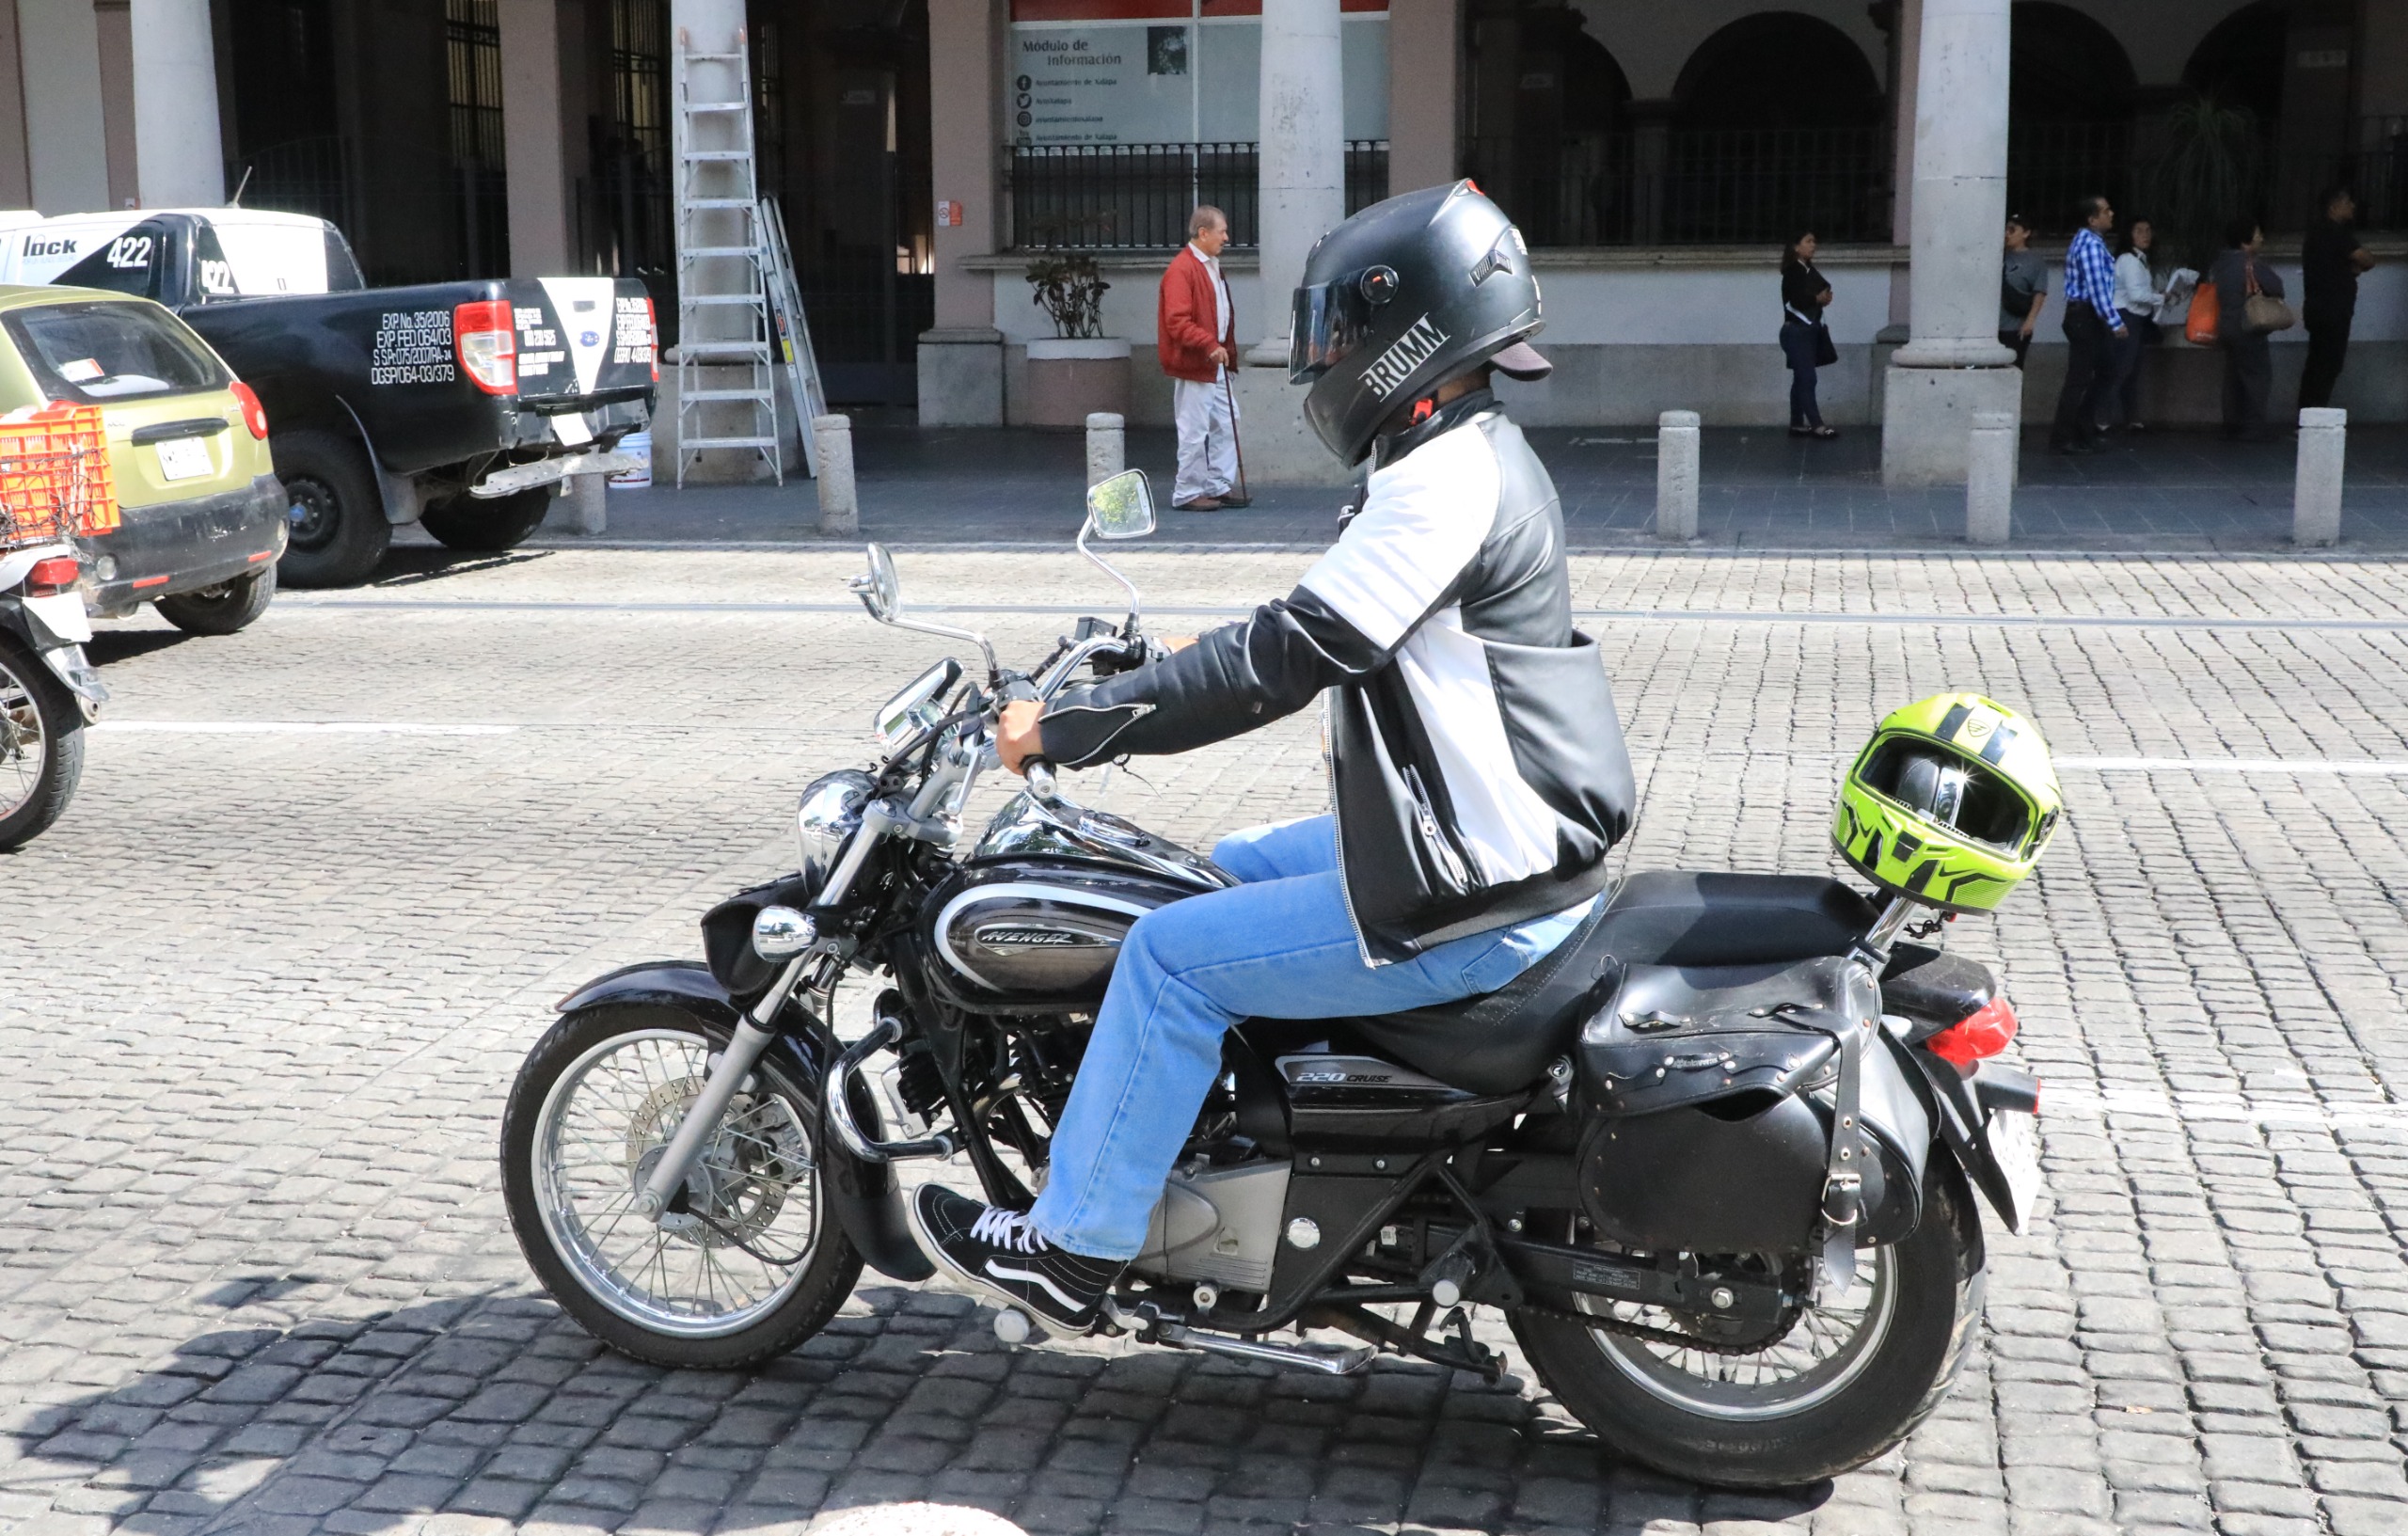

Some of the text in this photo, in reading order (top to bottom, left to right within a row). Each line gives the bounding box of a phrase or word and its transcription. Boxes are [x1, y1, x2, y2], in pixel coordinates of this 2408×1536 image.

[1022, 39, 1088, 52] Módulo de
[1047, 52, 1121, 66] Información
[106, 237, 152, 268] 422
[414, 310, 450, 328] 35/2006
[418, 328, 452, 346] 064/03
[1357, 311, 1450, 403] BRUMM
[981, 930, 1073, 944] AVENGER
[1296, 1072, 1392, 1083] 220 CRUISE
